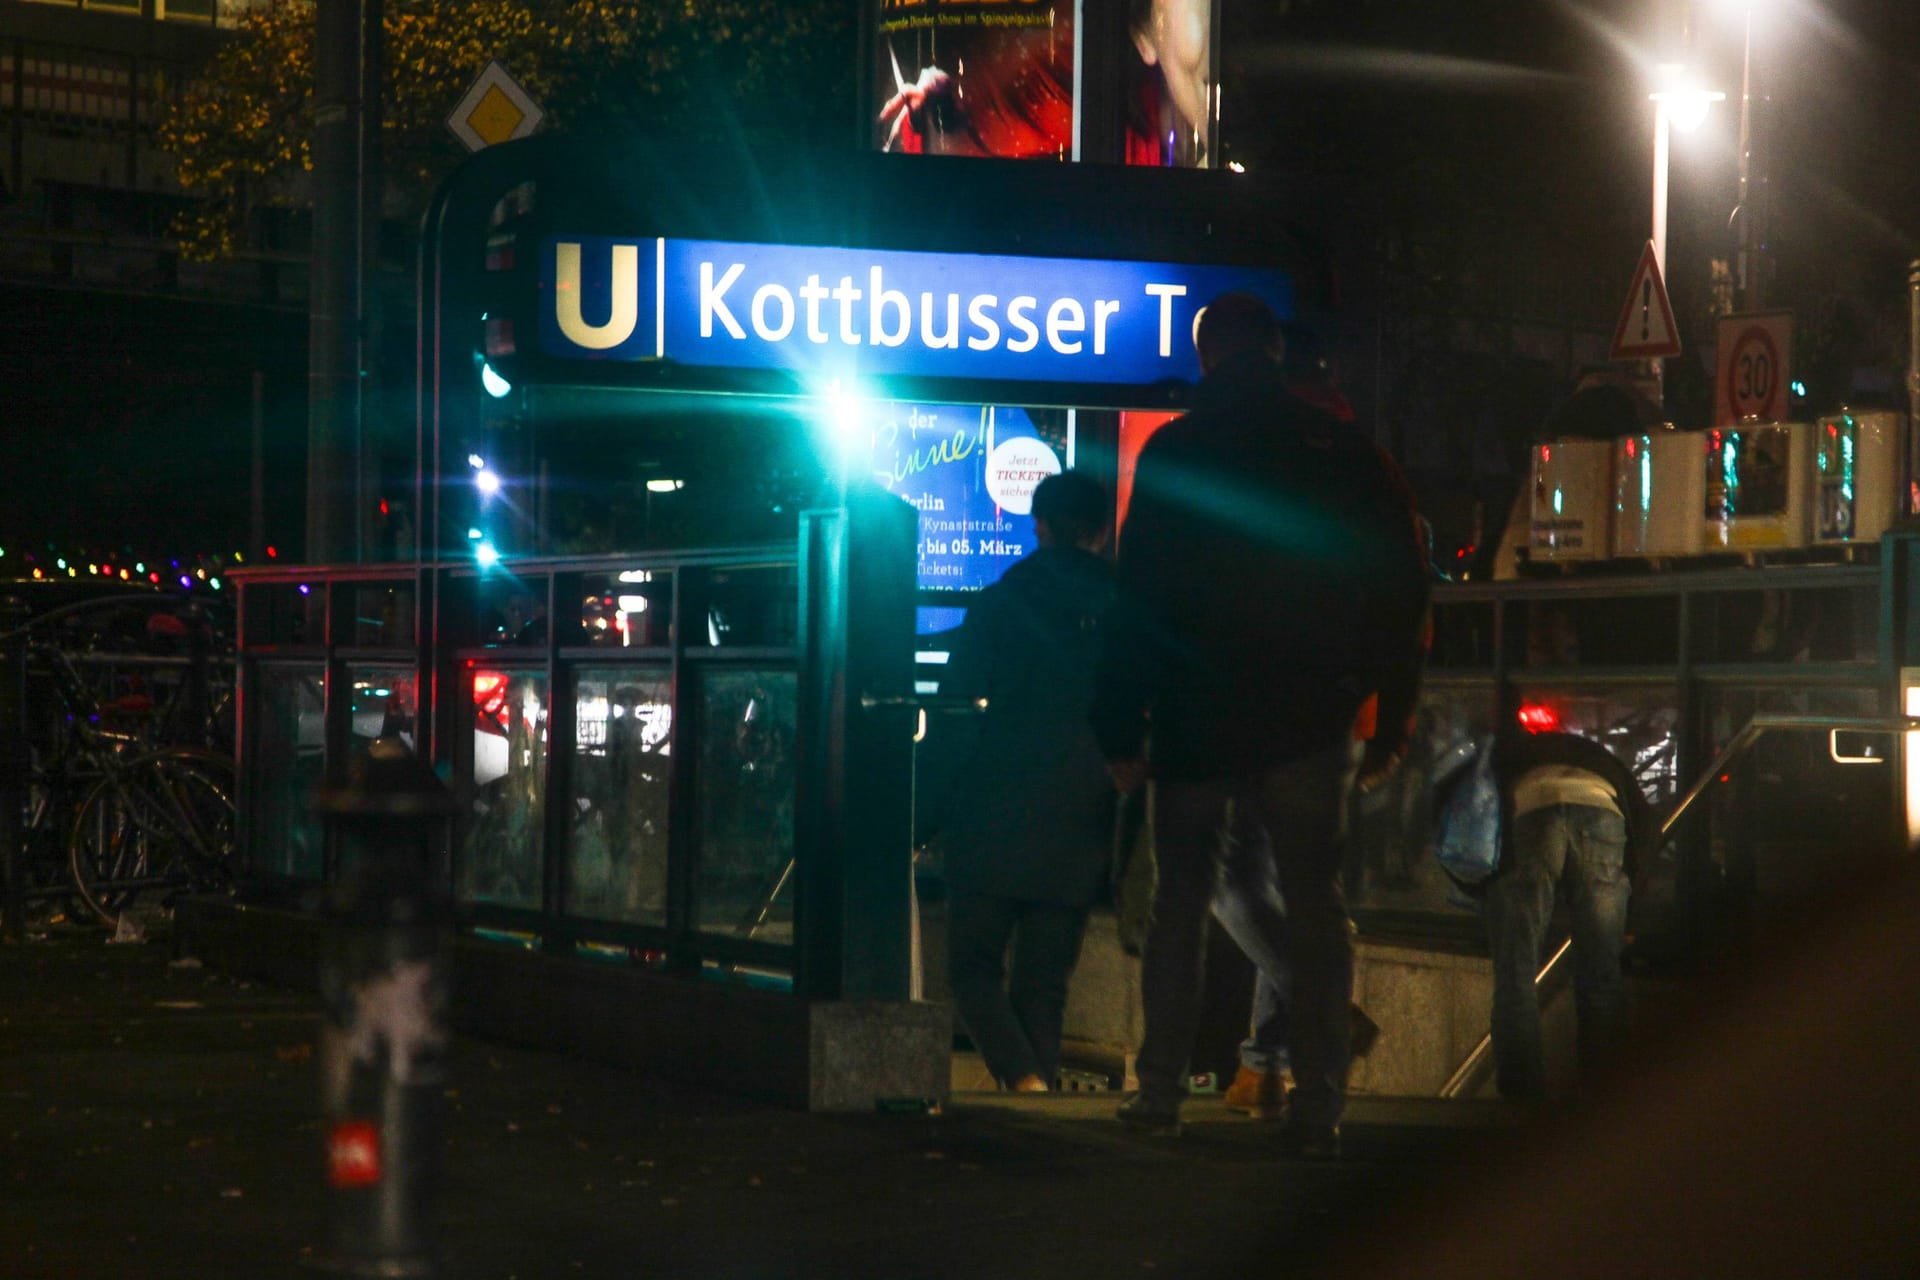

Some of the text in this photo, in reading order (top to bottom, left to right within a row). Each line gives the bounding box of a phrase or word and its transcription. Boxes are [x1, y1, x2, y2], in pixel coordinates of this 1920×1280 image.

[556, 242, 638, 349] U
[699, 261, 1120, 356] Kottbusser
[1738, 354, 1770, 400] 30
[909, 408, 938, 428] der
[1008, 454, 1039, 466] Jetzt
[924, 517, 1013, 534] Kynaststraße
[927, 538, 947, 555] bis
[951, 538, 974, 555] 05.
[979, 538, 1023, 555] März
